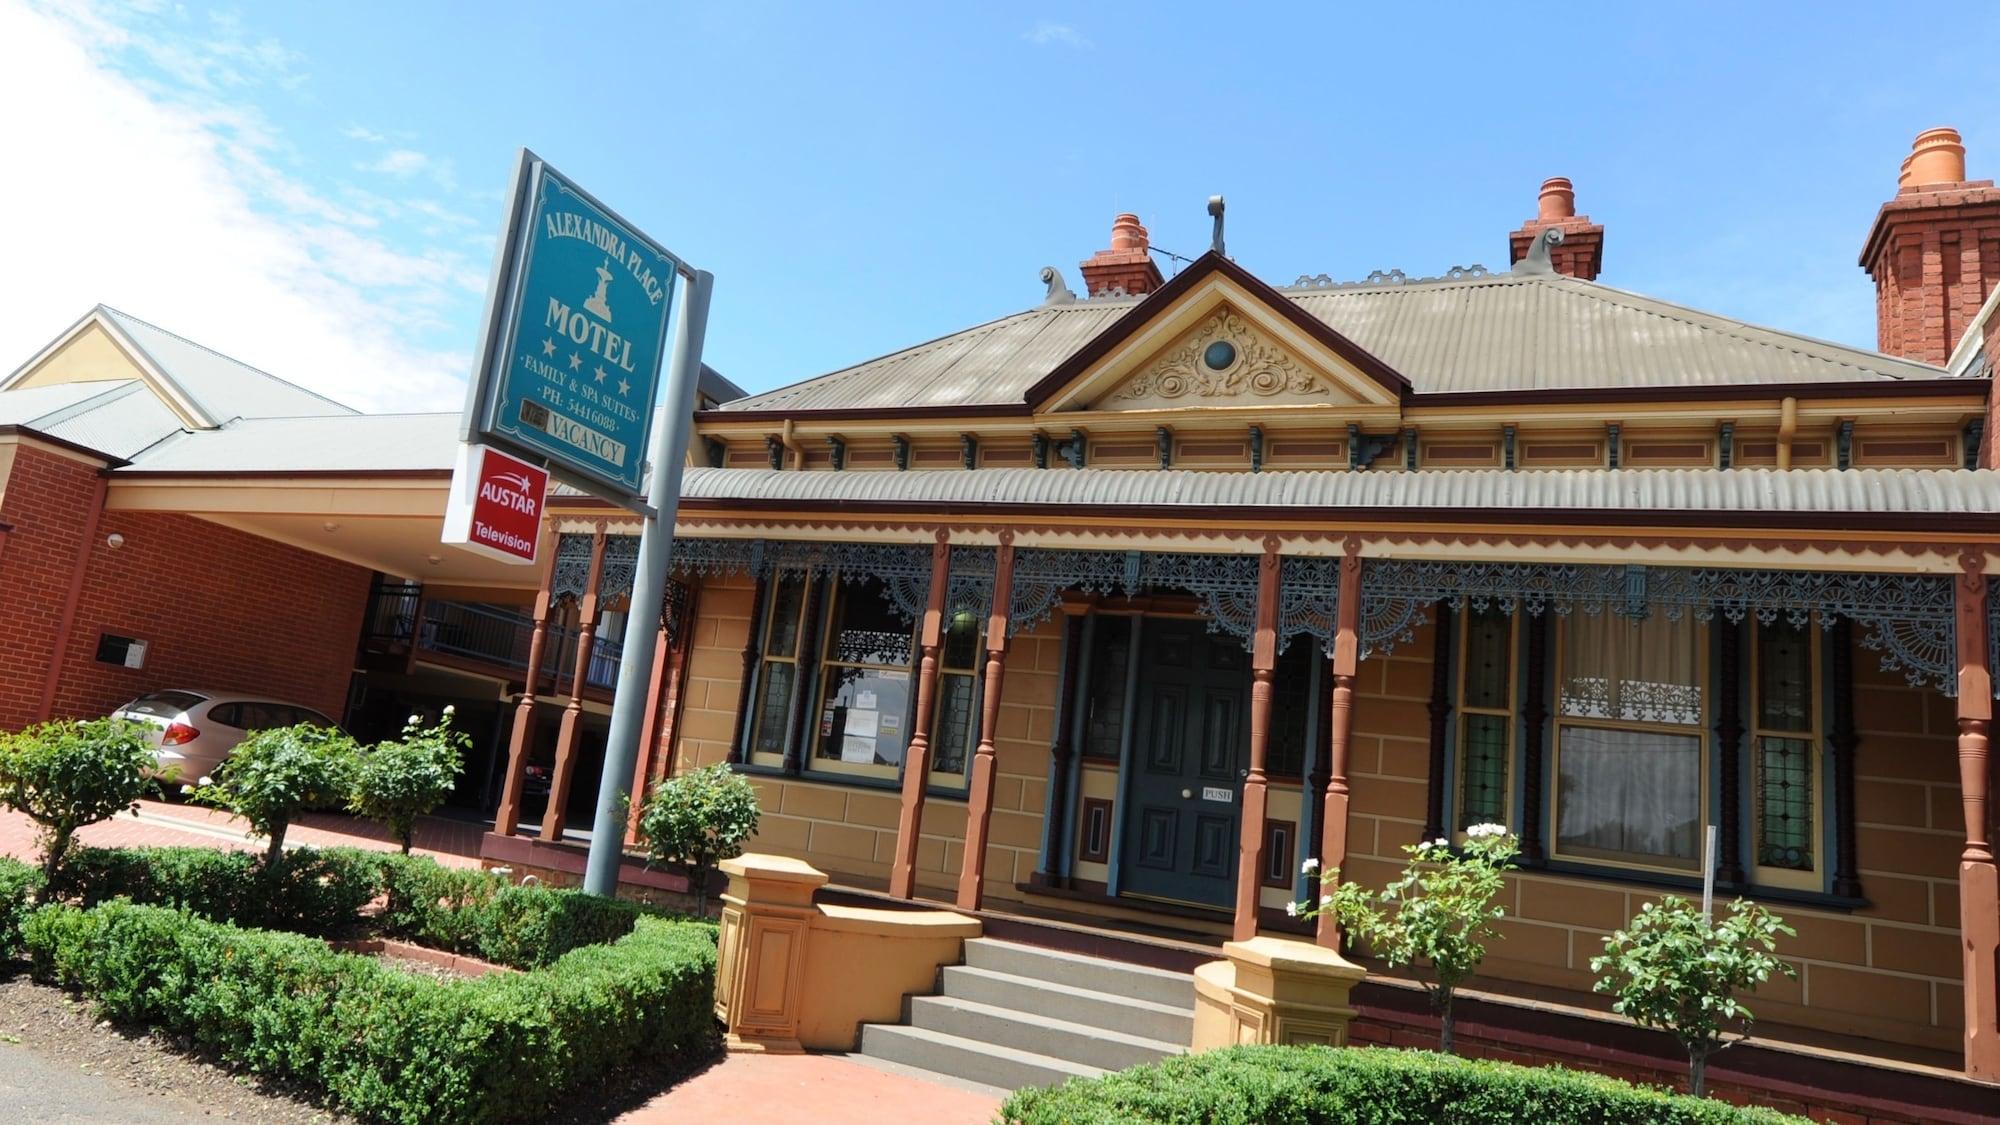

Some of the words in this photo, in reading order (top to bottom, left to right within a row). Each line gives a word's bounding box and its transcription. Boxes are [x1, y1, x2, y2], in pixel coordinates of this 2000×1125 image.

[546, 212, 625, 264] ALEXANDRA
[626, 250, 663, 306] PLACE
[544, 296, 636, 373] MOTEL
[524, 354, 567, 386] FAMILY
[568, 378, 578, 393] &
[581, 384, 599, 404] SPA
[601, 394, 637, 422] SUITES
[542, 385, 563, 407] PH:
[566, 399, 616, 432] 54416088
[552, 414, 621, 463] VACANCY
[480, 482, 536, 516] AUSTAR
[475, 521, 532, 553] Television
[1204, 788, 1232, 801] PUSH
